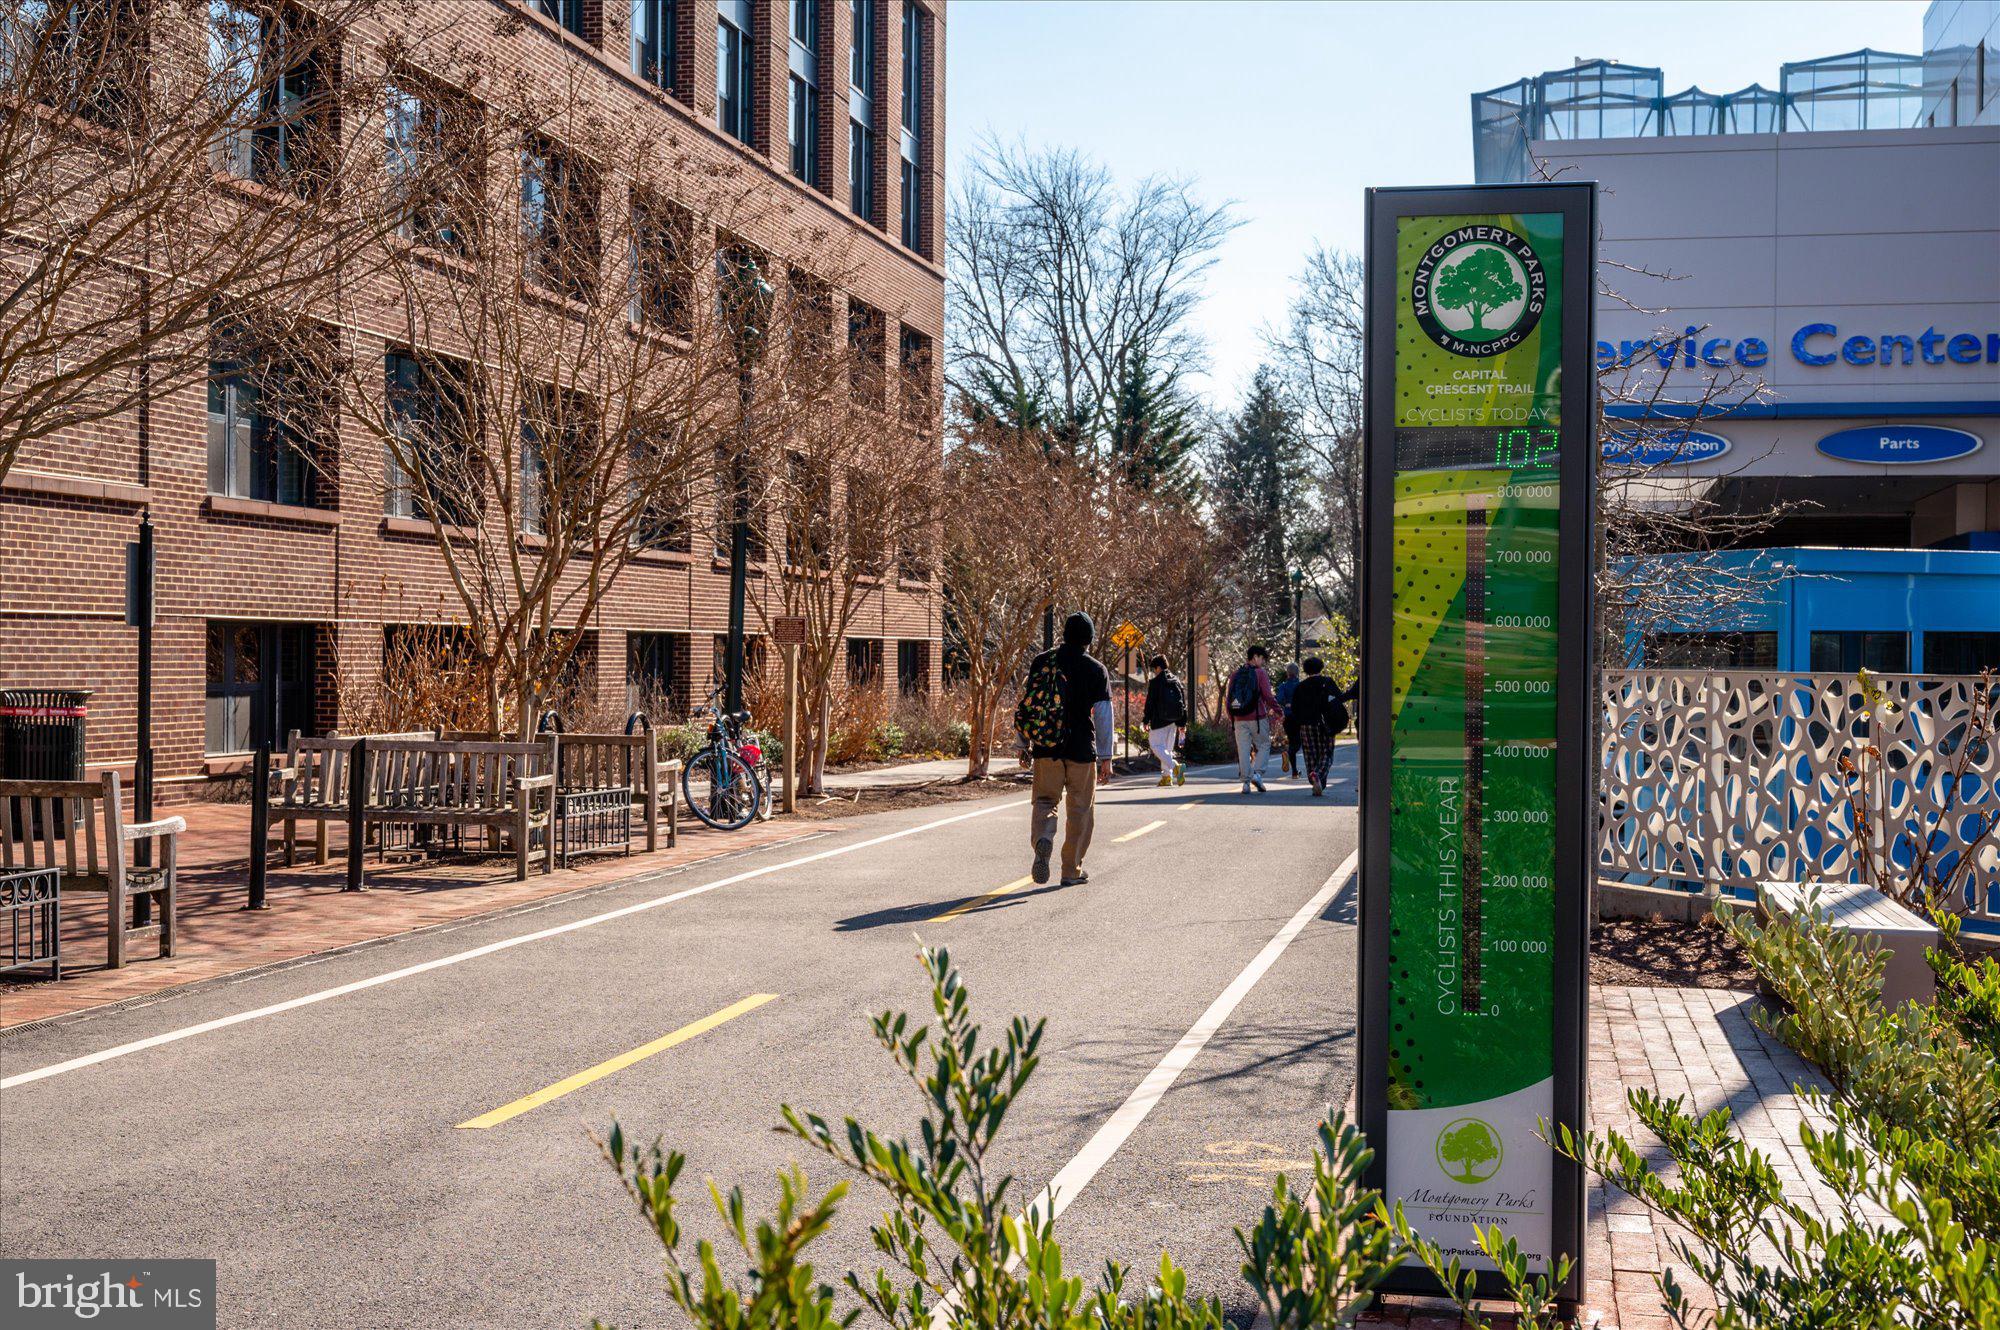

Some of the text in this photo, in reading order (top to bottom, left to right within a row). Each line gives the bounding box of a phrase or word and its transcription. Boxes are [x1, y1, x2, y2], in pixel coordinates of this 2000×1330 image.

[1414, 227, 1545, 316] MONTGOMERY PARKS
[1452, 332, 1521, 354] M-NCPPC
[1597, 325, 1768, 369] ervice
[1453, 370, 1507, 380] CAPITAL
[1426, 384, 1534, 395] CRESCENT TRAIL
[1406, 408, 1551, 422] CYCLISTS TODAY
[1496, 429, 1558, 468] 102
[1880, 435, 1920, 451] Parts
[1497, 485, 1552, 498] 800 000
[1496, 550, 1551, 563] 700 000
[1495, 615, 1551, 628] 600 000
[1495, 681, 1550, 693] 500 000
[1493, 746, 1549, 758] 400 000
[1493, 810, 1548, 824] 300 000
[1492, 875, 1548, 888] 200 000
[1438, 779, 1458, 1015] CYCLISTS THIS YEAR
[1493, 940, 1547, 953] 100 000
[1491, 1004, 1500, 1017] 0
[1406, 1188, 1536, 1217] Montgomery Parks
[1428, 1213, 1508, 1225] FOUNDATION
